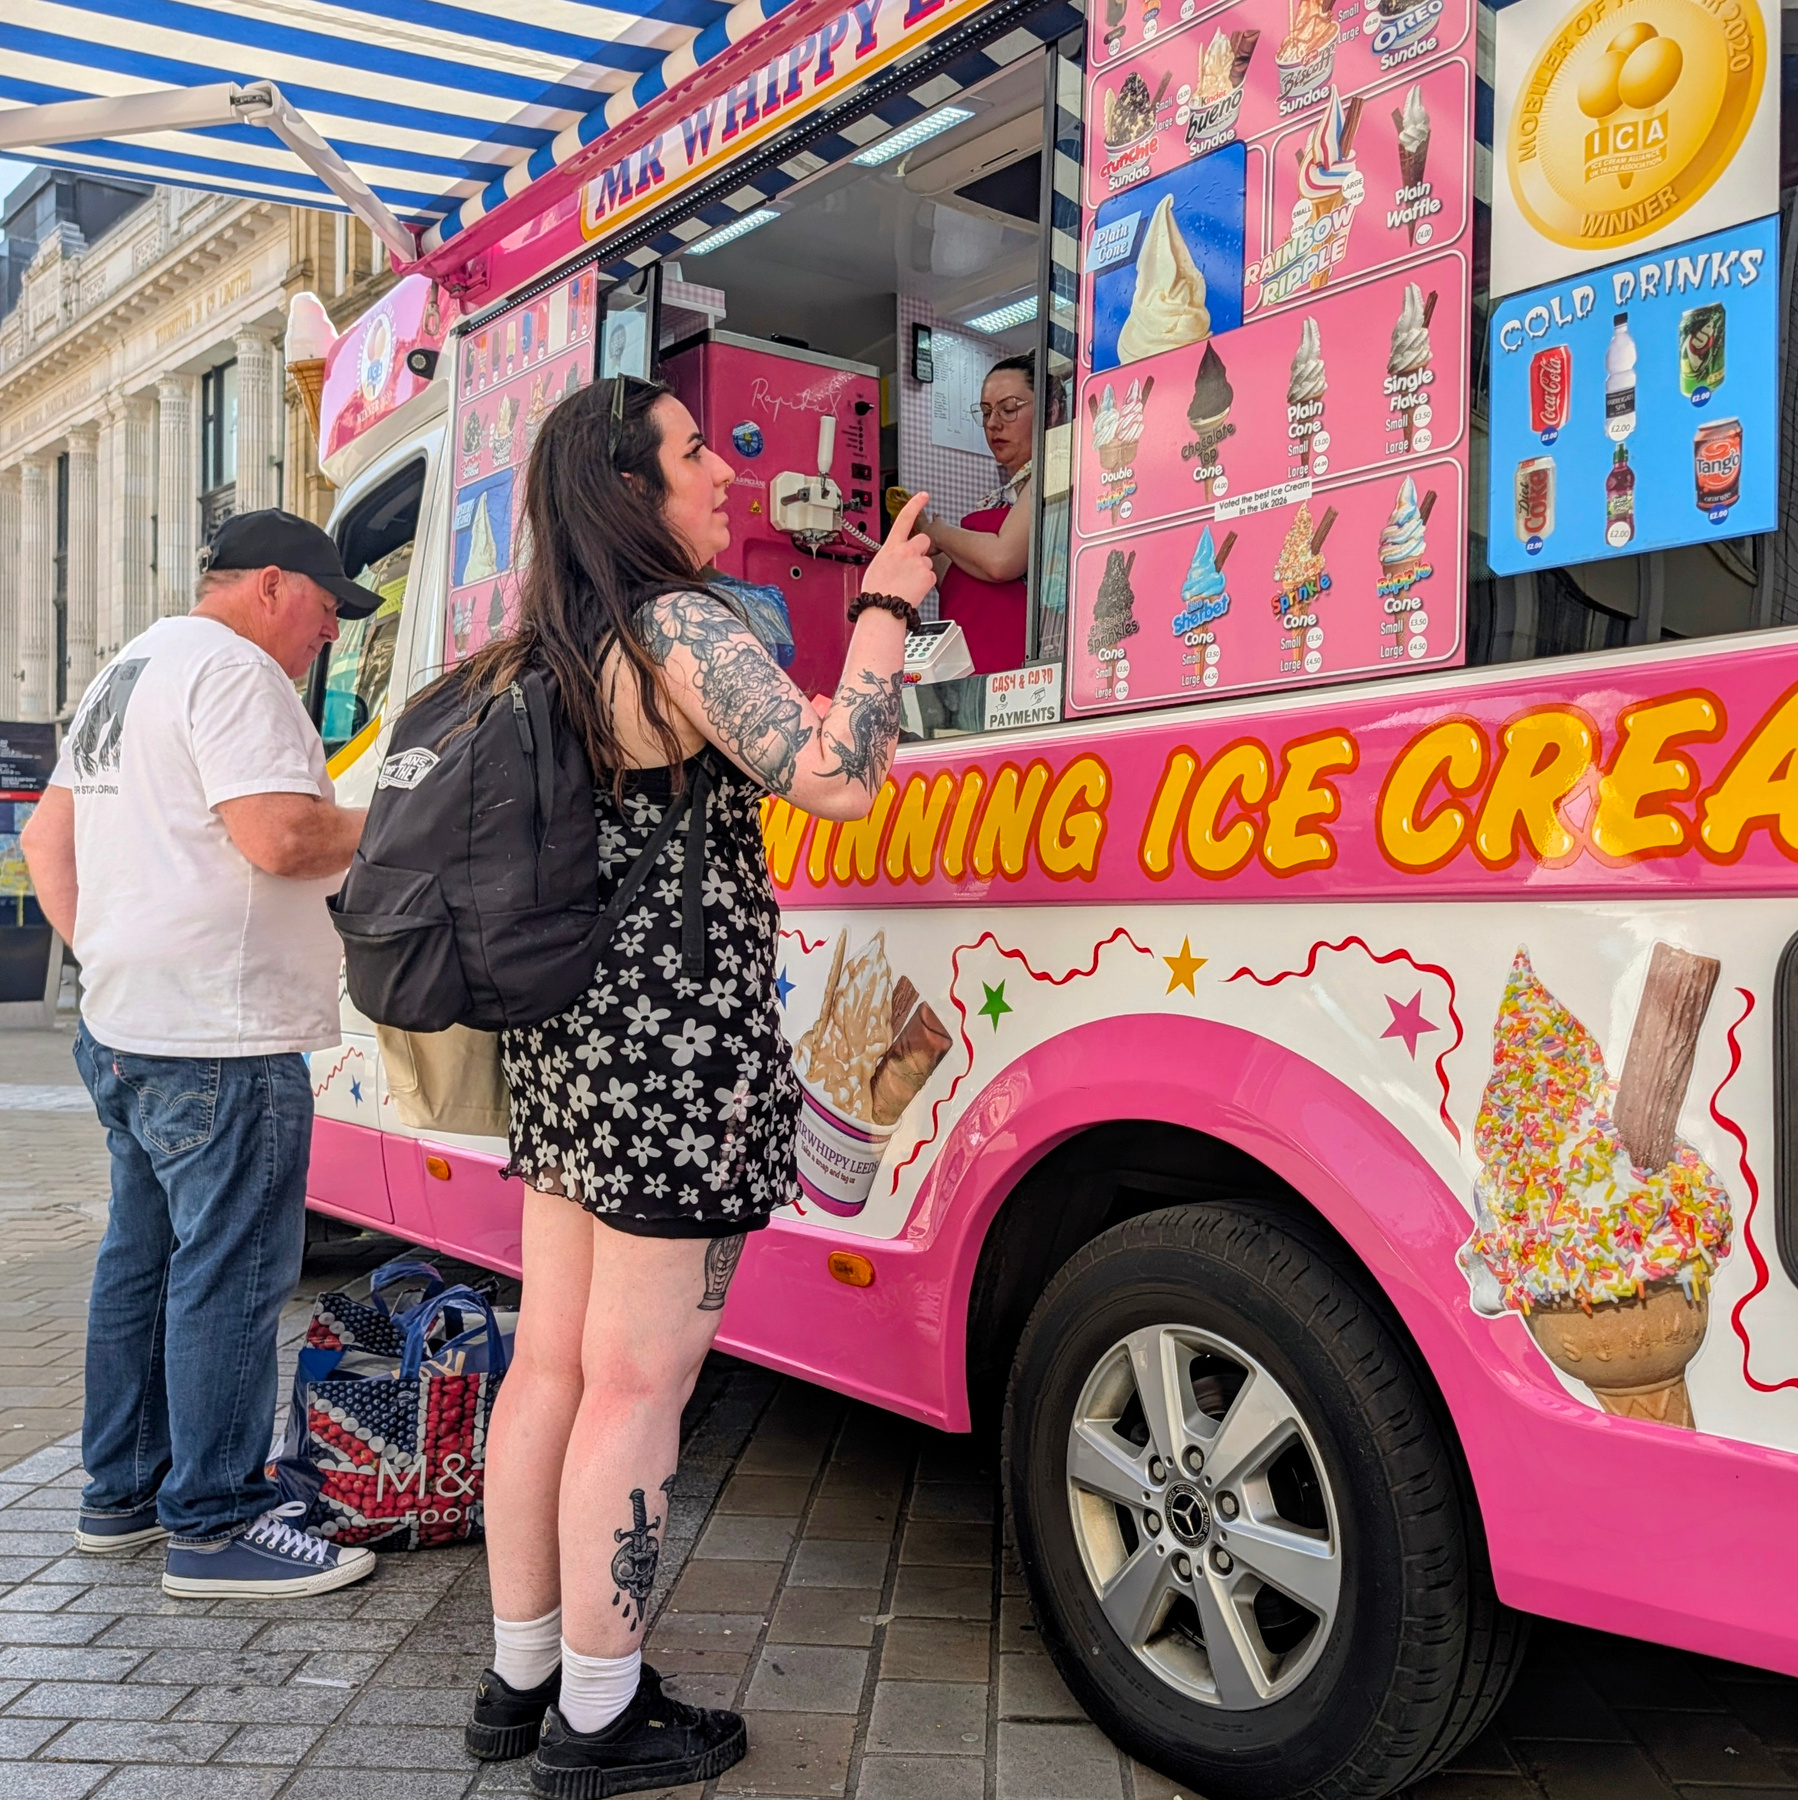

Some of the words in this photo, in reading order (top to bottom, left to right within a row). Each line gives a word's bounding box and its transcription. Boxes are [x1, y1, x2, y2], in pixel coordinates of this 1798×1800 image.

[1338, 3, 1360, 22] Small
[1338, 26, 1360, 43] Large
[1373, 0, 1443, 53] OREO
[1723, 3, 1751, 73] 2020
[1380, 37, 1438, 71] Sundae
[1518, 36, 1574, 163] MOBILER
[1575, 1, 1607, 37] OF
[1155, 96, 1173, 113] Small
[1200, 89, 1227, 107] Kinder
[1279, 87, 1330, 116] Sundae
[596, 138, 666, 220] MR
[677, 0, 882, 167] WHIPPY
[1185, 89, 1243, 144] bueno
[1155, 117, 1173, 132] Large
[1189, 129, 1236, 157] Sundae
[1593, 118, 1665, 155] ICA
[1100, 137, 1159, 179] crunchie
[1600, 164, 1620, 175] TRADE
[1620, 156, 1662, 171] ASSOCIATION
[1603, 157, 1627, 167] CREAM
[1628, 150, 1661, 163] ALLIANCE
[1108, 165, 1151, 191] Sundae
[1343, 177, 1364, 192] LARGE
[1395, 181, 1431, 205] Plain
[1292, 205, 1312, 219] SMALL
[1387, 198, 1441, 228] Waffle
[1580, 185, 1678, 237] WINNER
[1095, 223, 1129, 250] Plain
[1244, 202, 1357, 288] RAINBOW
[1098, 242, 1129, 263] Cone
[1262, 234, 1348, 306] RIPPLE
[1499, 285, 1596, 352] COLD
[1612, 249, 1763, 306] DRINKS
[1383, 369, 1434, 395] Single
[1390, 391, 1429, 412] Flake
[1692, 391, 1711, 403] £2.00
[1287, 400, 1323, 423] Plain
[1385, 414, 1408, 431] Small
[1414, 411, 1431, 421] £3.50
[1288, 419, 1322, 439] Cone
[1541, 431, 1558, 442] £2.00
[1610, 423, 1631, 433] £2.00
[1287, 441, 1309, 457] Small
[1314, 436, 1329, 447] £3.00
[1385, 439, 1409, 454] Large
[1414, 434, 1431, 445] £4.50
[1287, 465, 1309, 479] Large
[1696, 450, 1740, 475] Tango
[1101, 466, 1134, 485] Double
[1193, 464, 1224, 482] Cone
[1219, 496, 1241, 511] Voted
[1241, 494, 1253, 506] the
[1253, 489, 1270, 503] best
[1284, 479, 1311, 494] Cream
[1247, 503, 1258, 514] the
[1709, 509, 1728, 520] £2.00
[1609, 529, 1630, 539] £2.00
[1526, 541, 1543, 551] £2.00
[1377, 562, 1432, 596] Ripple
[1270, 573, 1331, 614] Sprinkle
[1172, 593, 1230, 635] Sherbet
[1384, 597, 1422, 613] Cone
[1283, 614, 1317, 629] Cone
[1380, 620, 1404, 636] Small
[1410, 617, 1427, 626] £3.50
[1184, 632, 1215, 646] Cone
[1280, 636, 1302, 650] Small
[1307, 633, 1323, 642] £3.50
[1098, 648, 1126, 661] Cone
[1181, 651, 1201, 666] Small
[1206, 650, 1220, 659] £3.50
[1380, 645, 1404, 659] Large
[1409, 641, 1427, 651] £4.50
[1095, 667, 1113, 679] Small
[1280, 659, 1302, 673] Large
[1306, 657, 1322, 666] £4.50
[903, 672, 922, 684] AP
[1018, 674, 1026, 690] &
[1181, 675, 1201, 688] Large
[1204, 672, 1218, 681] £4.50
[1095, 688, 1112, 699] Large
[989, 705, 1056, 728] PAYMENTS
[394, 765, 416, 782] THE
[81, 785, 95, 795] STP
[95, 784, 119, 795] ORING
[759, 752, 1112, 888] WINNING
[1139, 727, 1359, 883] ICE
[815, 1157, 829, 1174] snap
[829, 1168, 840, 1180] and
[850, 1160, 879, 1176] LEEDS
